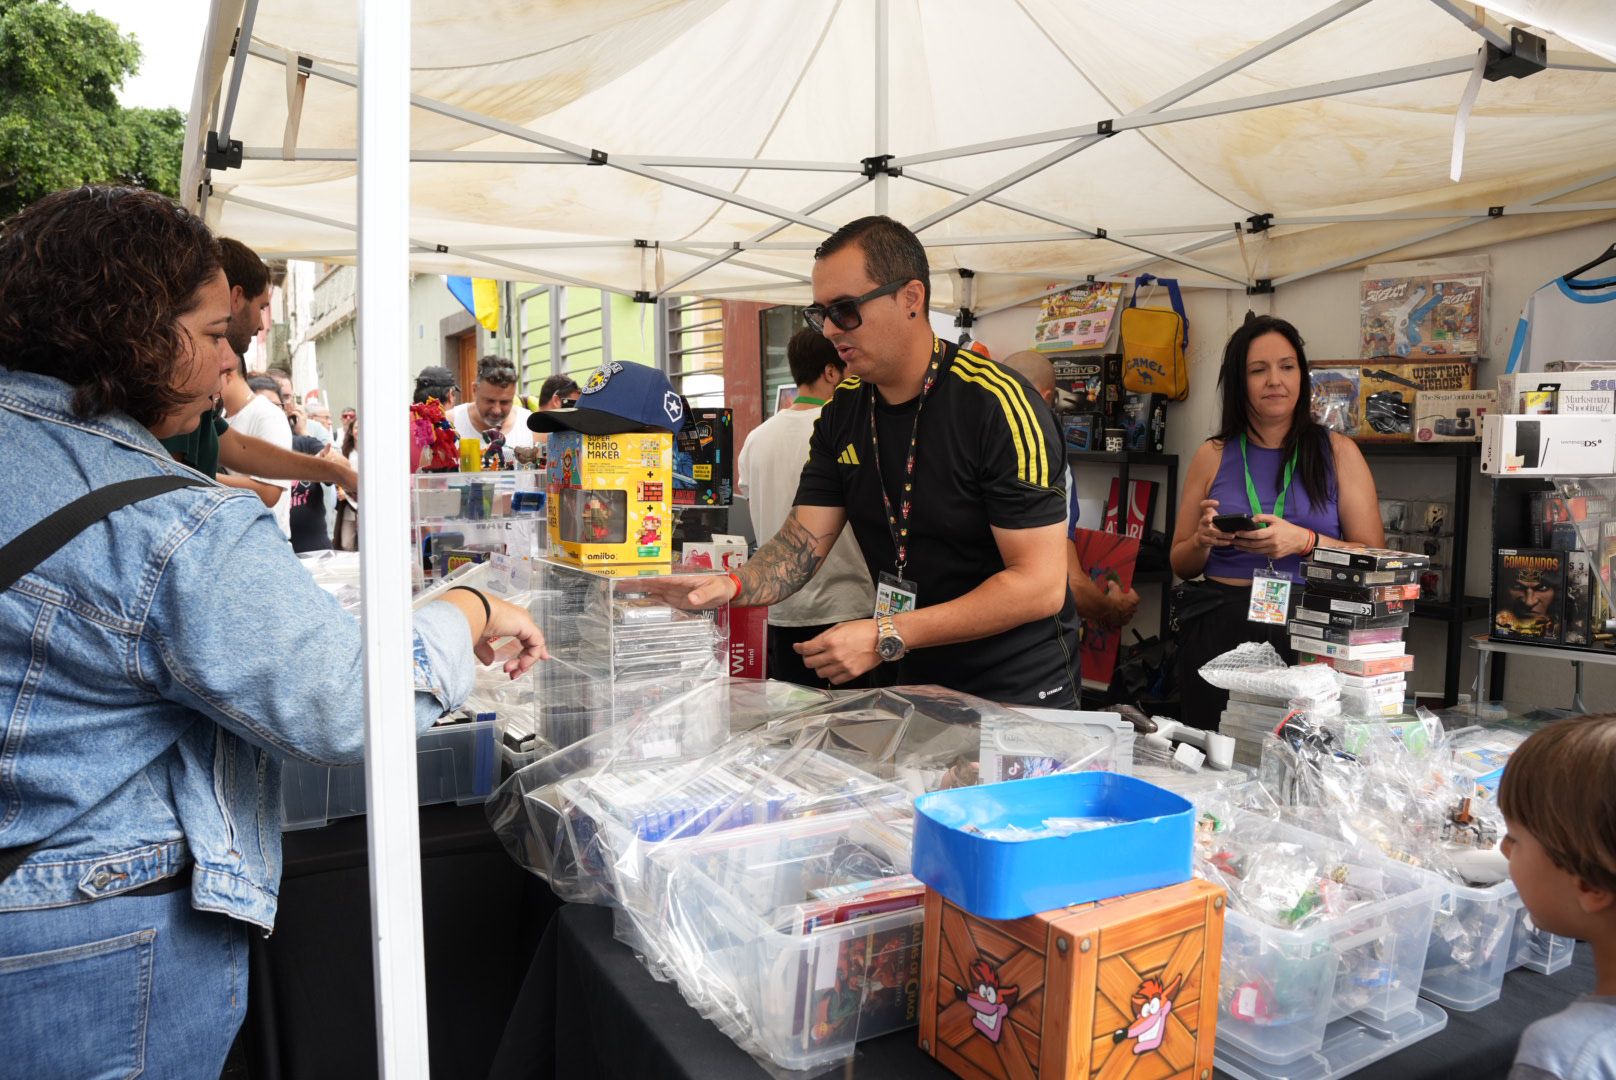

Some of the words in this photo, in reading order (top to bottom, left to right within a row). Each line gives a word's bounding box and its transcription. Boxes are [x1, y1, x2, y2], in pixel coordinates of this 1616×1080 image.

[1063, 366, 1094, 374] DRIVE
[1126, 357, 1166, 376] CAMEL
[1412, 365, 1470, 379] WESTERN
[1420, 377, 1463, 390] HEROES
[1590, 379, 1616, 391] SEG
[1565, 395, 1610, 405] Marksman
[587, 433, 610, 442] SUPER
[587, 441, 618, 451] MARIO
[587, 450, 620, 460] MAKER
[1105, 520, 1143, 539] ARI
[587, 550, 616, 560] amiibo
[1503, 554, 1559, 571] COMMANDOS
[731, 643, 745, 675] Wii
